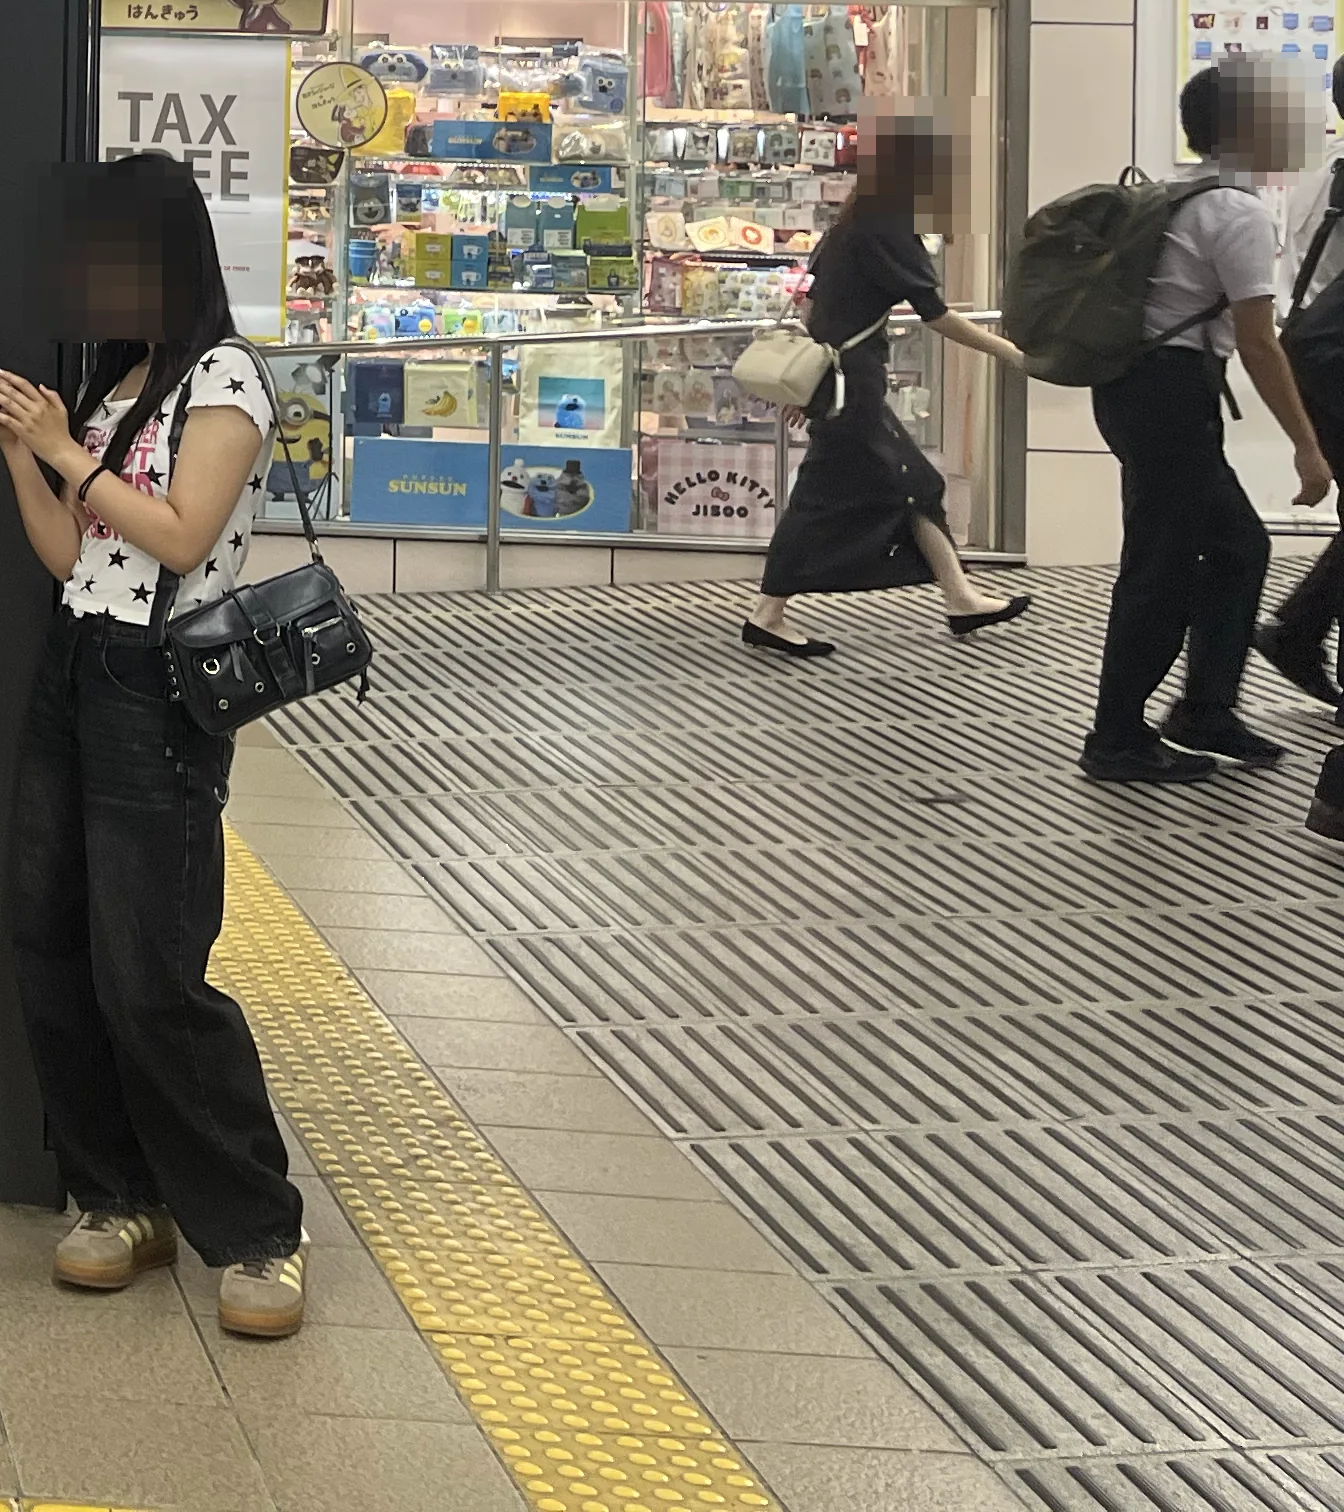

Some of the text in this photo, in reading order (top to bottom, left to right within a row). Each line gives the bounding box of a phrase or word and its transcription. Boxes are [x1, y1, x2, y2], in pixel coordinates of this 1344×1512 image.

[127, 4, 199, 21] はんきゅう
[118, 91, 238, 145] TAX
[106, 147, 250, 202] EE
[388, 479, 468, 497] SUNSUN
[664, 469, 776, 509] HELLO KITTY
